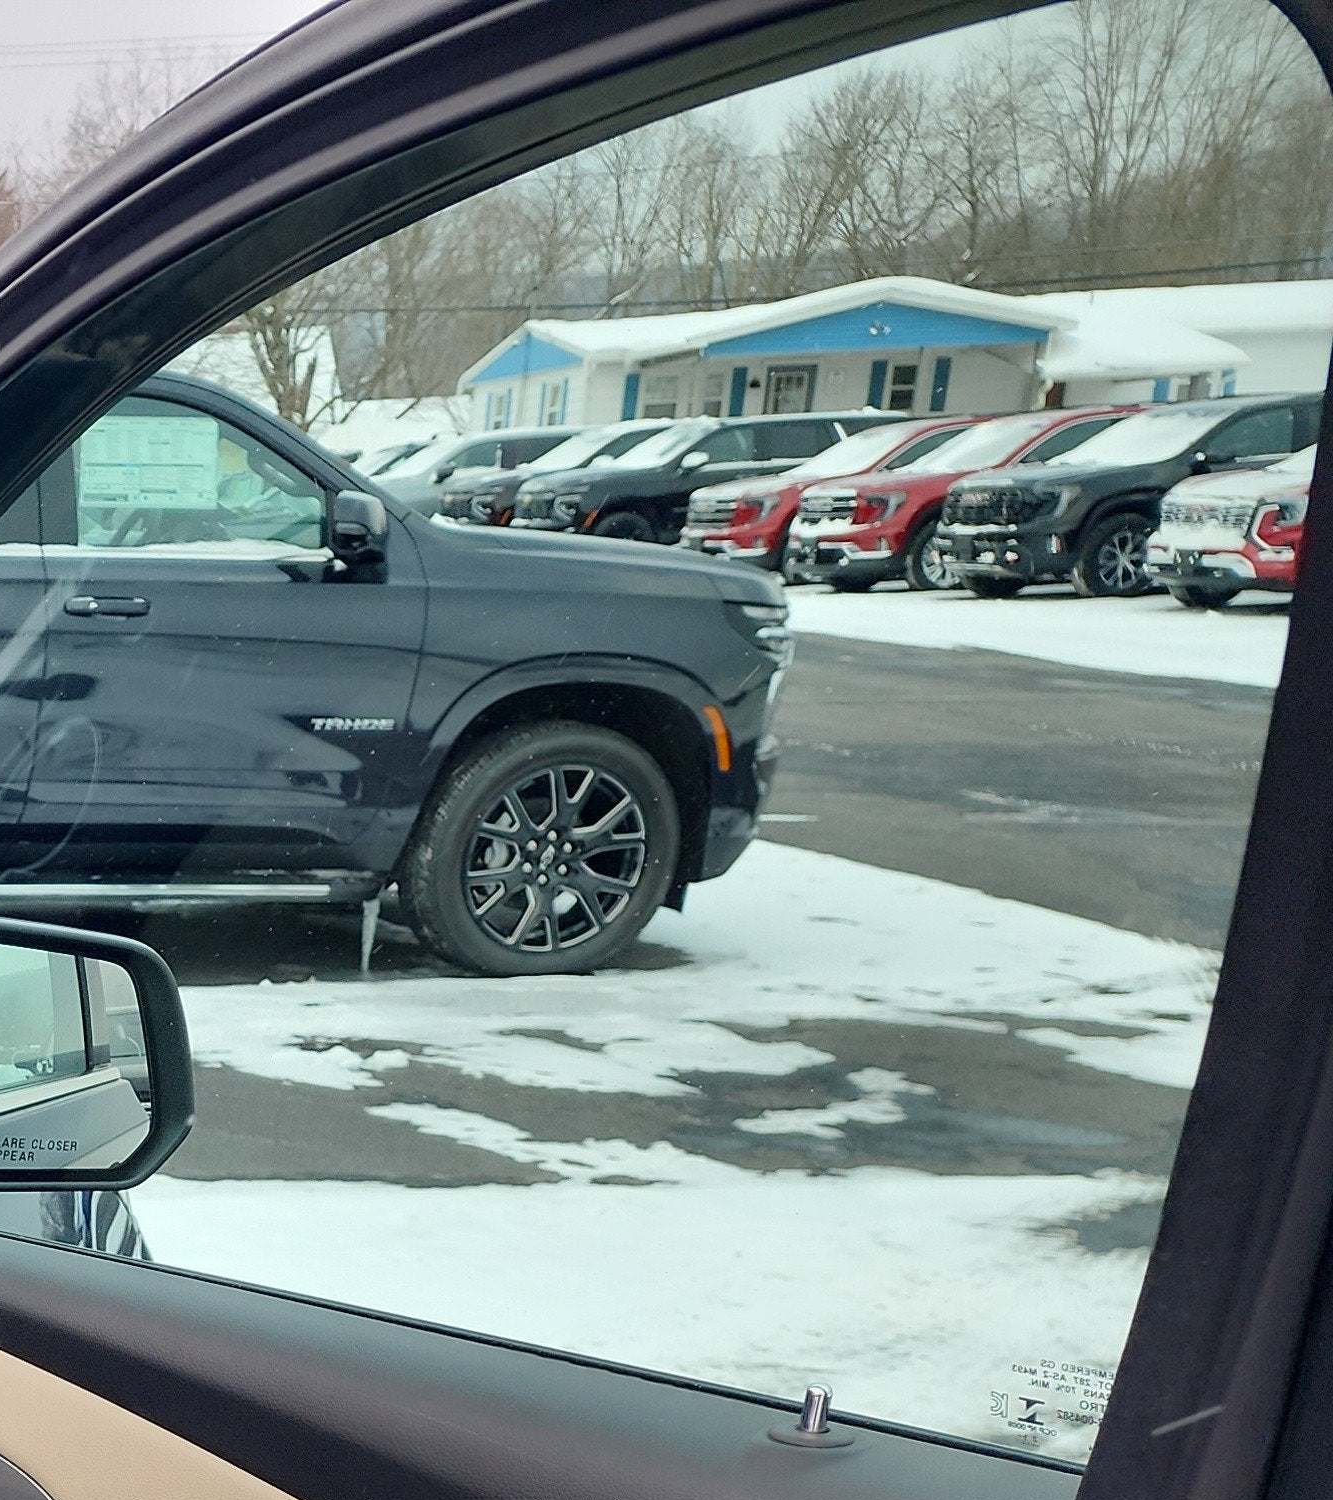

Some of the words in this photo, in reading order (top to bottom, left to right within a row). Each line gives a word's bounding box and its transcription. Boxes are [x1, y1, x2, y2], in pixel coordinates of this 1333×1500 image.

[310, 717, 395, 731] TAHOE
[2, 1137, 26, 1149] ARE
[31, 1139, 78, 1152] CLOSER
